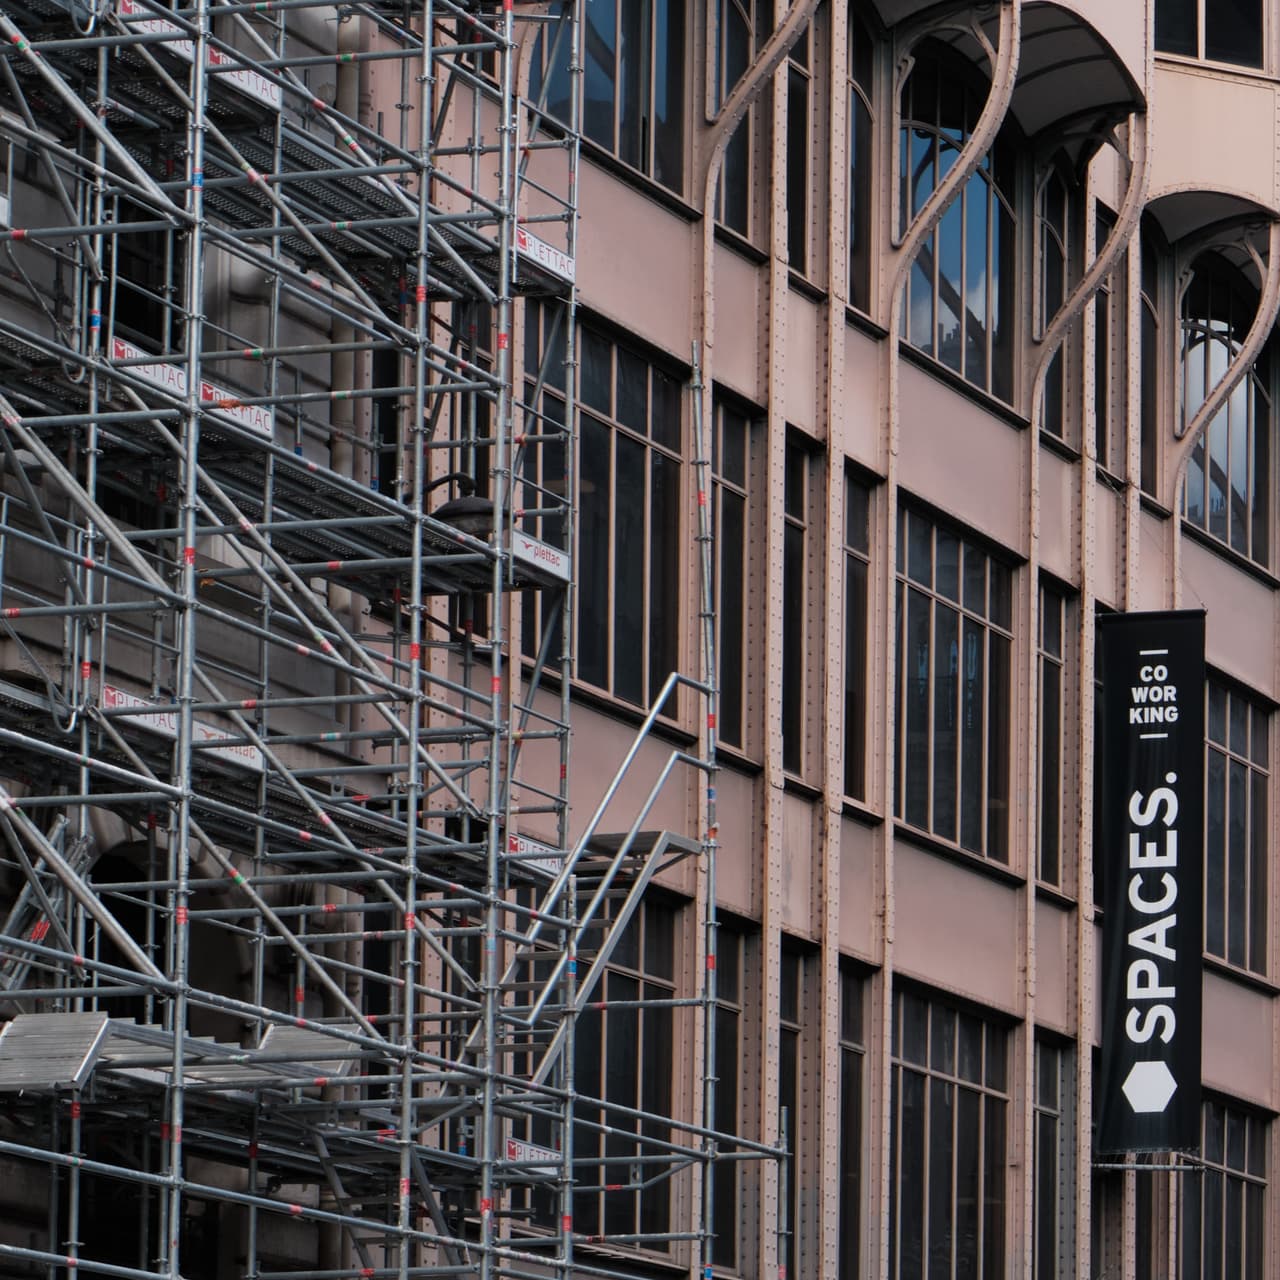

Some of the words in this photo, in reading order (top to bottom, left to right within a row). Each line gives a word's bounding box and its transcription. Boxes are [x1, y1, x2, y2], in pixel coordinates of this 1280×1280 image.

[528, 236, 573, 275] PLETTAC
[534, 545, 561, 567] plettac
[1139, 665, 1168, 683] CO
[1131, 685, 1177, 703] WOR
[1129, 705, 1179, 725] KING
[1126, 771, 1178, 1044] SPACES.
